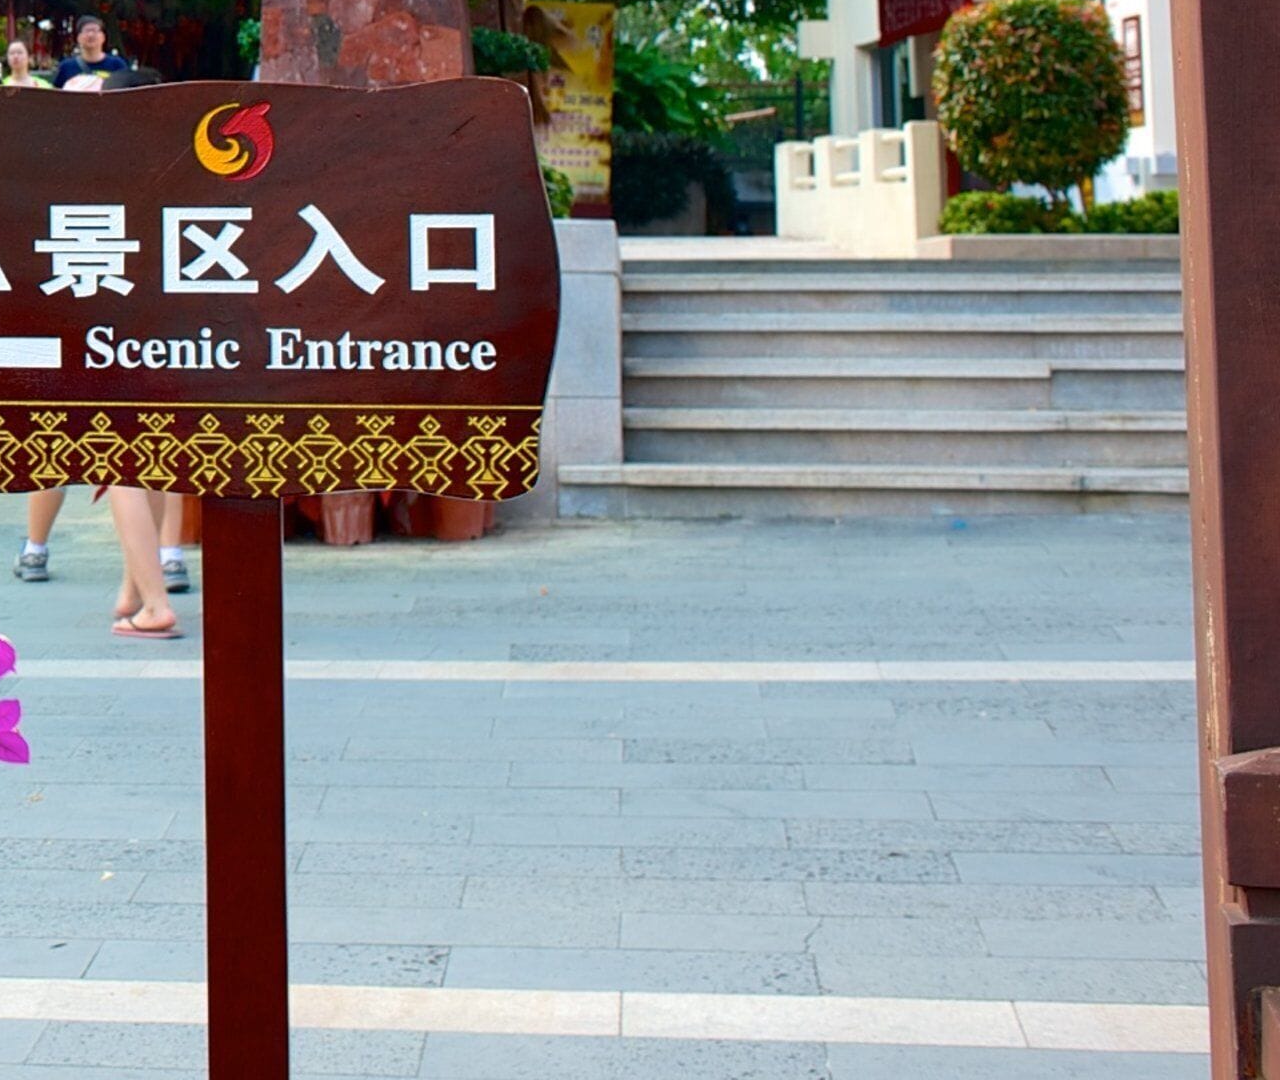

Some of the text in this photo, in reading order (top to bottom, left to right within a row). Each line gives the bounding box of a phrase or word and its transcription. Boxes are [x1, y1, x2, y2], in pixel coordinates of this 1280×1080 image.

[34, 203, 496, 297] 景区入口
[85, 326, 497, 371] Scenic Entrance
